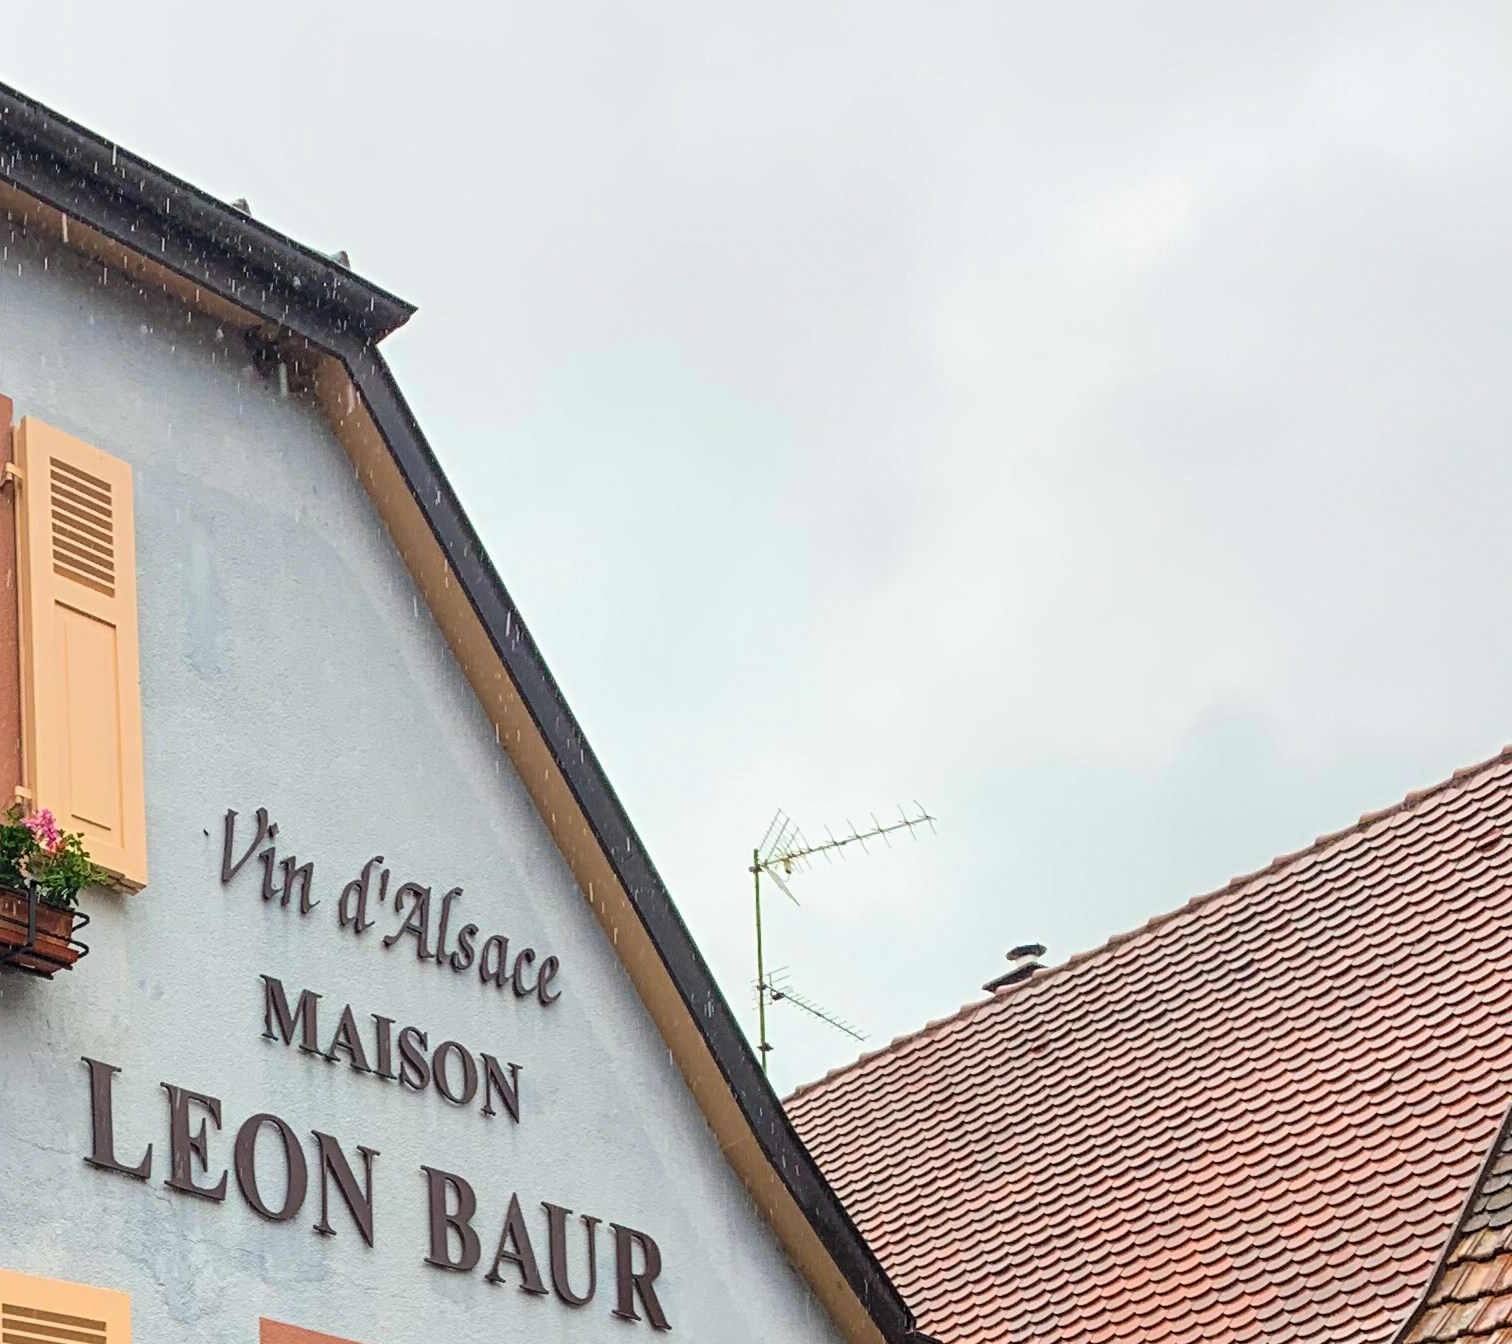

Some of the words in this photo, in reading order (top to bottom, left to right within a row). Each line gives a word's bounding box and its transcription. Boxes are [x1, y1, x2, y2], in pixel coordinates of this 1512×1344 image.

[220, 807, 321, 916] Vin
[338, 855, 563, 1005] d'Alsace
[259, 973, 525, 1125] MAISON
[80, 1055, 382, 1249] LEON
[419, 1164, 673, 1332] BAUR
